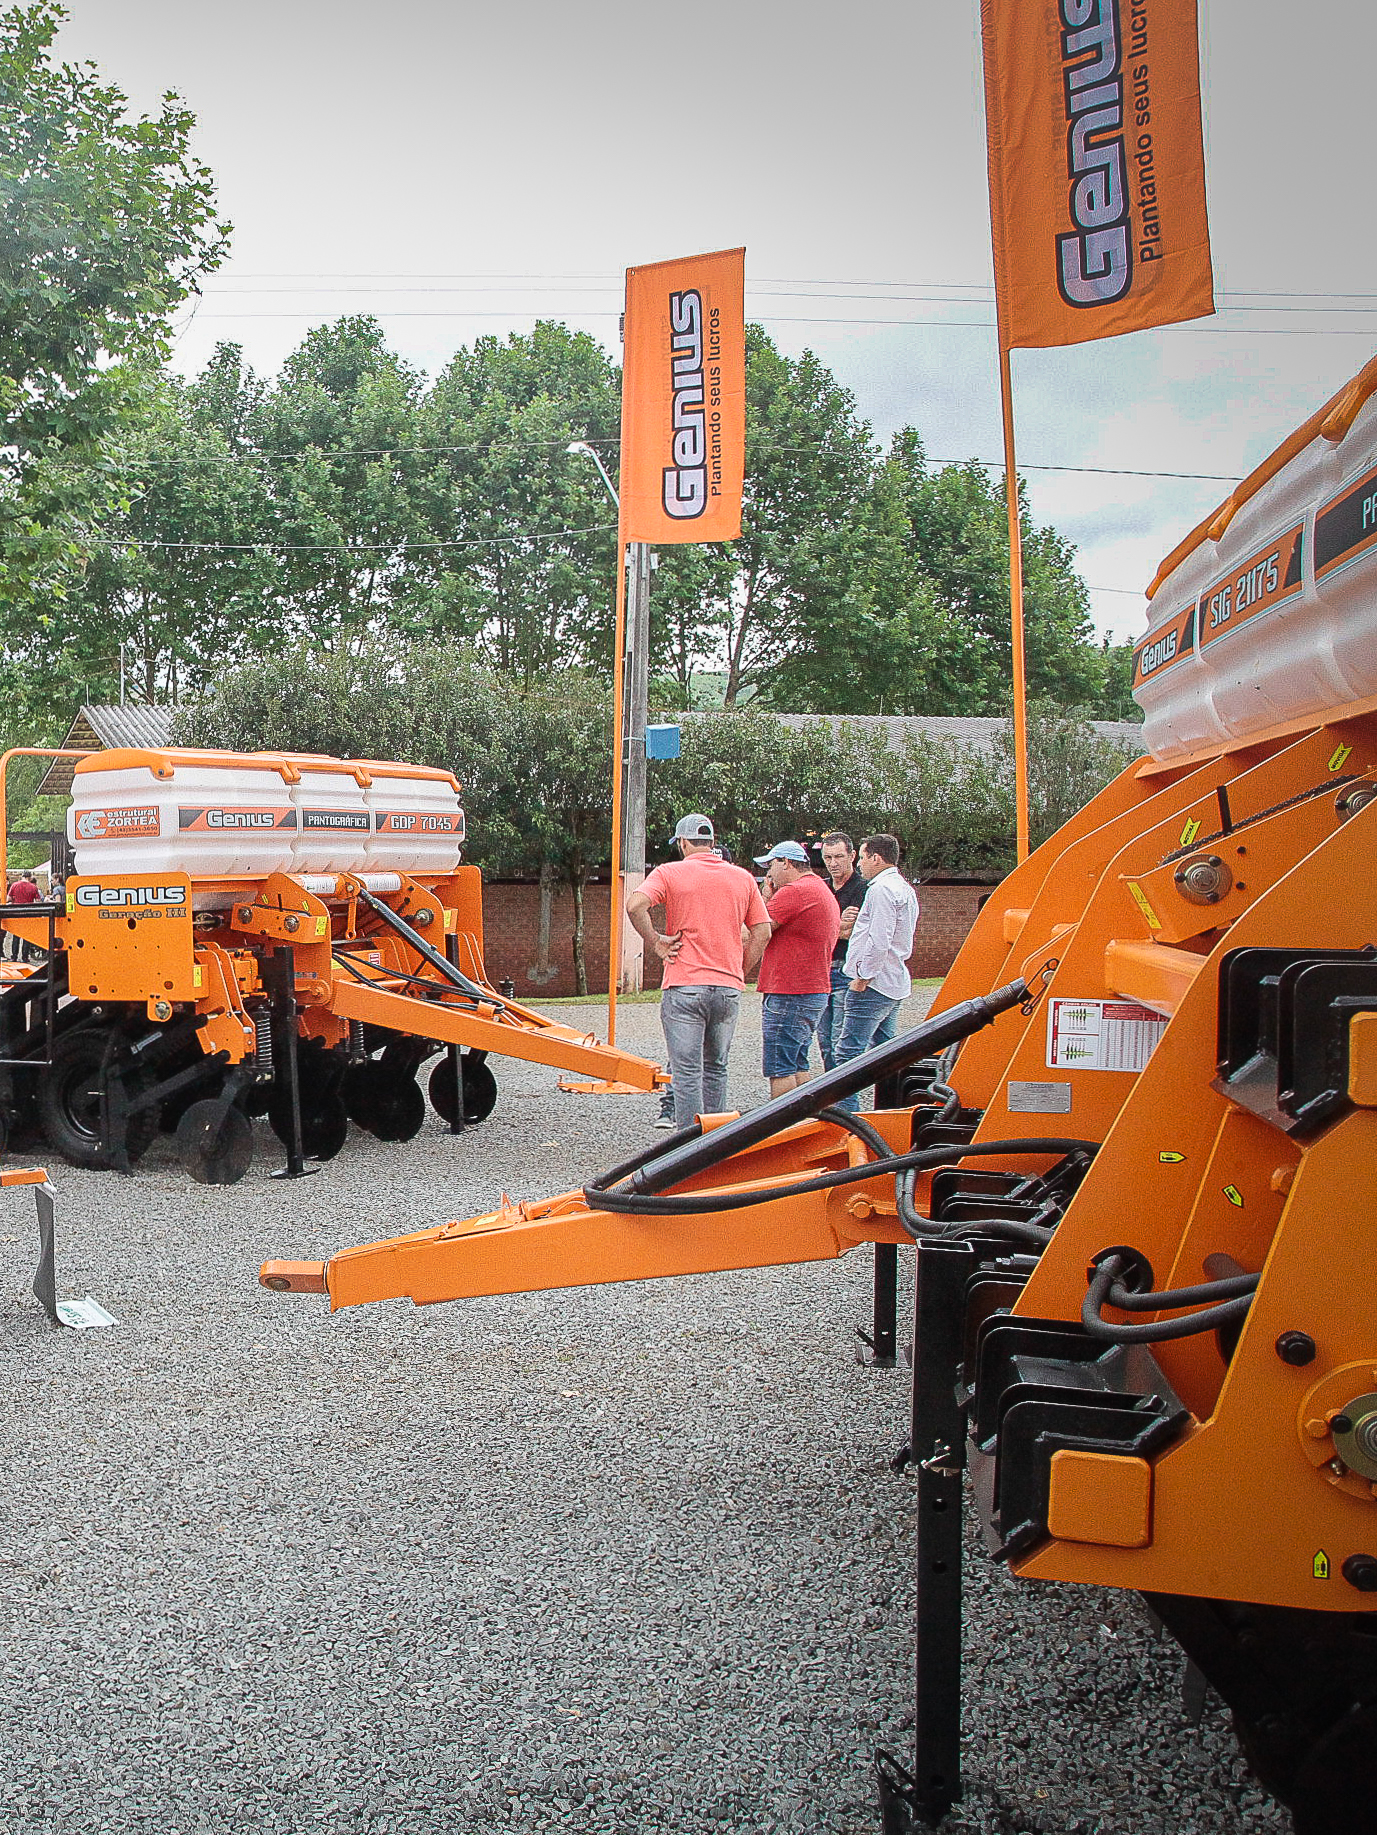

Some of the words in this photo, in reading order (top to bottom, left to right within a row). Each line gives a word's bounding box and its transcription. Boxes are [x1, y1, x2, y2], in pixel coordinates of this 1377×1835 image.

[1130, 64, 1151, 126] seus
[1134, 132, 1164, 264] Plantando
[708, 308, 720, 362] lucros
[661, 288, 707, 520] Genius
[710, 367, 721, 406] seus
[710, 412, 722, 496] Plantando
[1210, 586, 1232, 628] SIG
[1236, 552, 1280, 613] 21175
[1141, 629, 1178, 676] Genius
[107, 807, 157, 818] estrutural
[107, 816, 157, 827] ZORTEA
[206, 809, 275, 828] Genius
[308, 814, 367, 828] PANTOGRÁFICA
[390, 815, 416, 830] GDP
[420, 816, 453, 831] 7045
[76, 884, 186, 906] Genius
[98, 908, 162, 920] Geração
[166, 907, 186, 918] III
